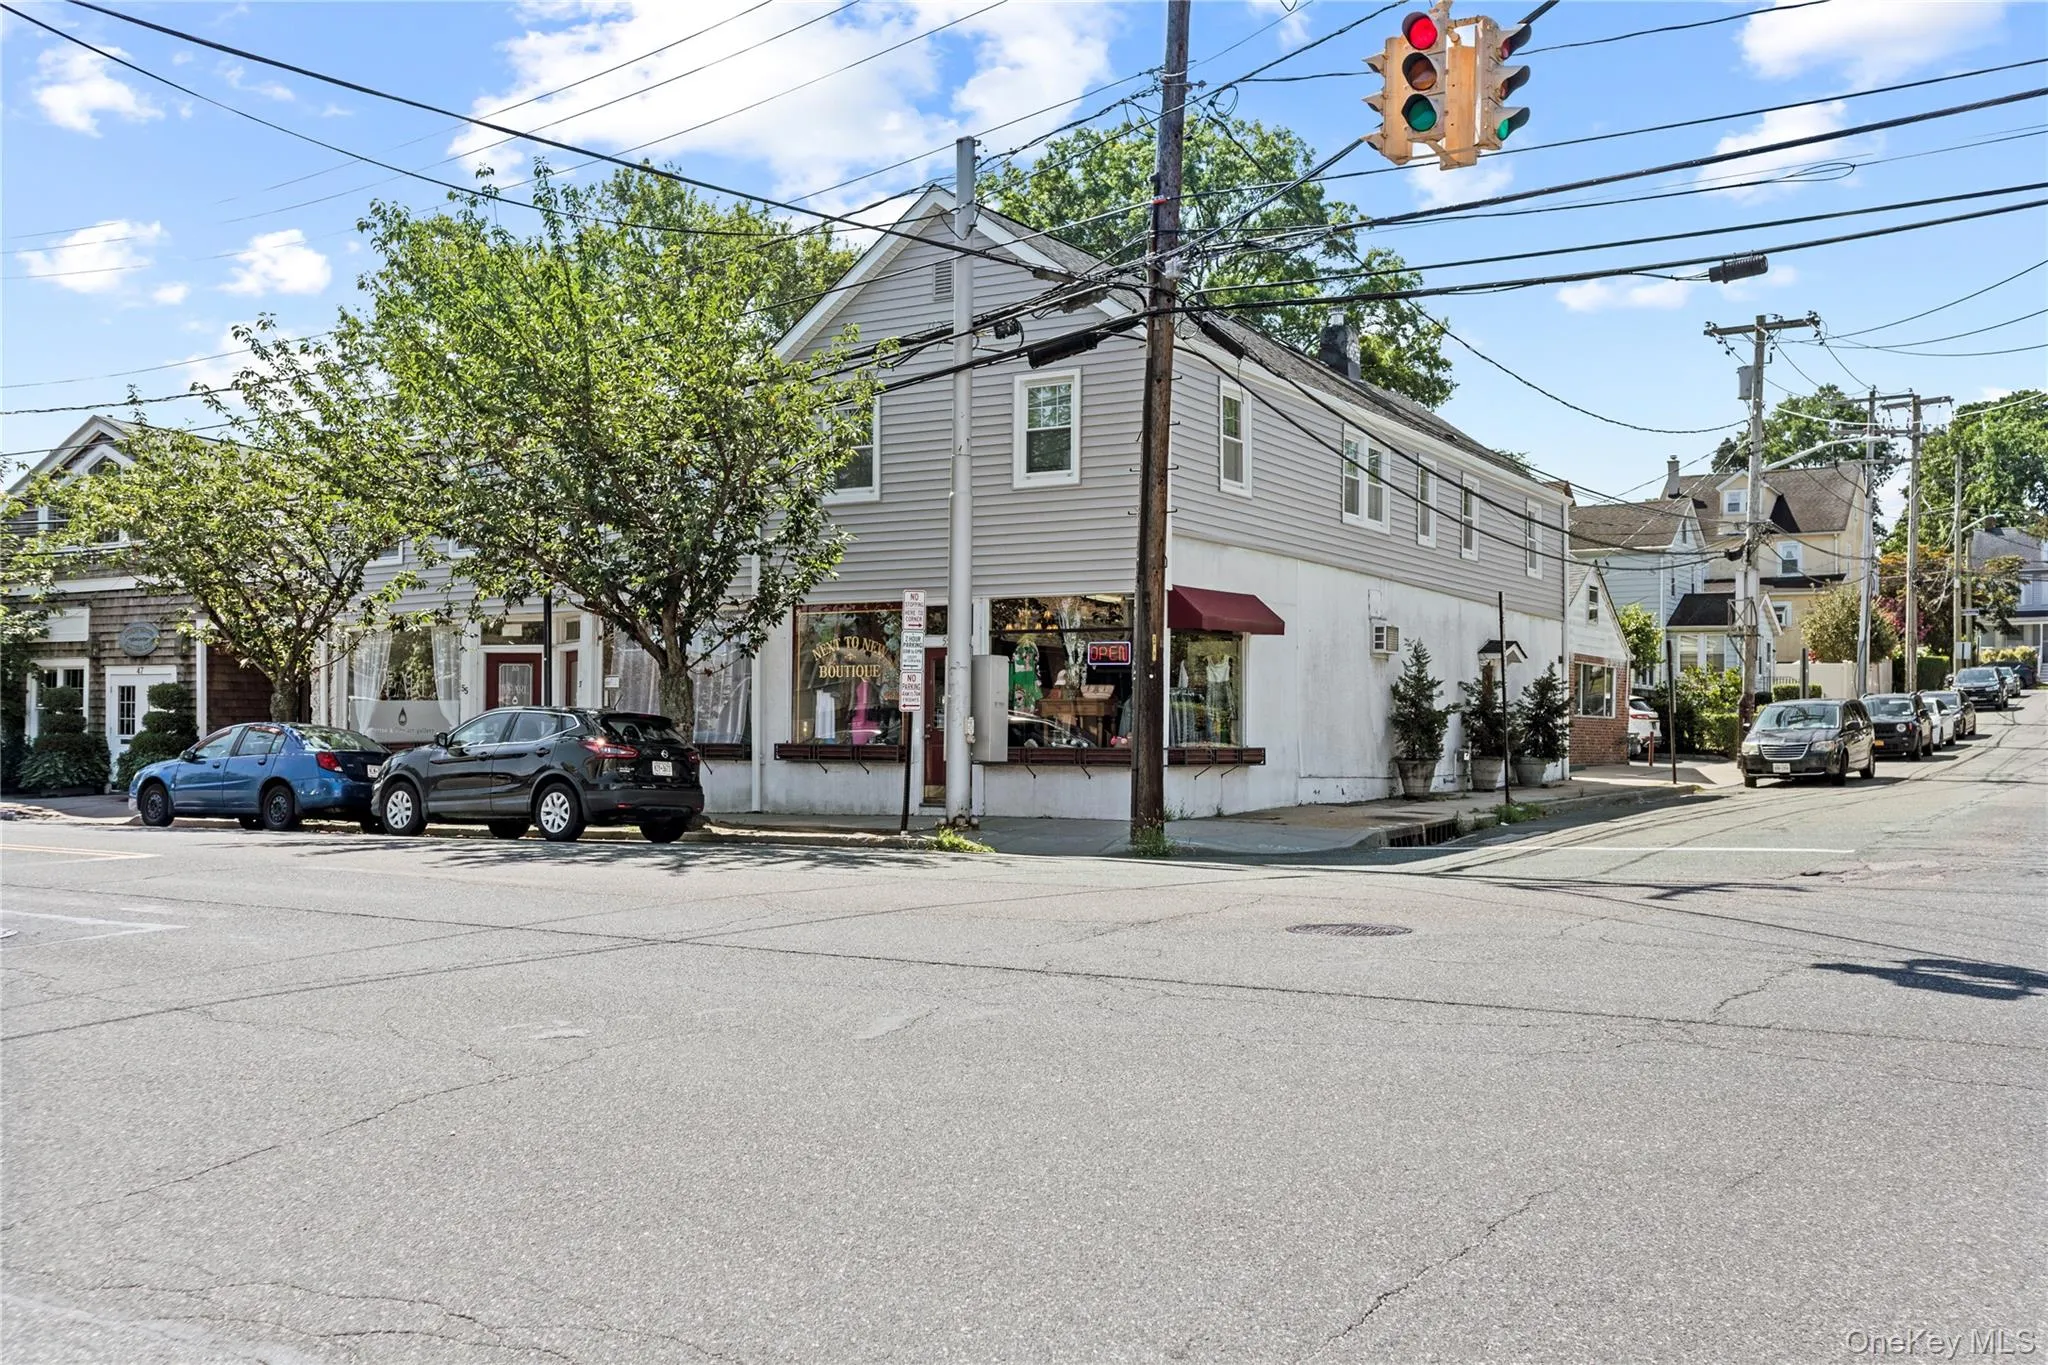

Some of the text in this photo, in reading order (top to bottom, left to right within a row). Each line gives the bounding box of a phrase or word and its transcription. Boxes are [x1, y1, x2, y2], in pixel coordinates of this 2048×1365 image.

[812, 636, 888, 661] NEXT TO NEW
[1091, 645, 1128, 662] OPEN
[136, 666, 144, 674] 47
[819, 664, 881, 683] BOUTIQUE
[907, 674, 916, 682] NO
